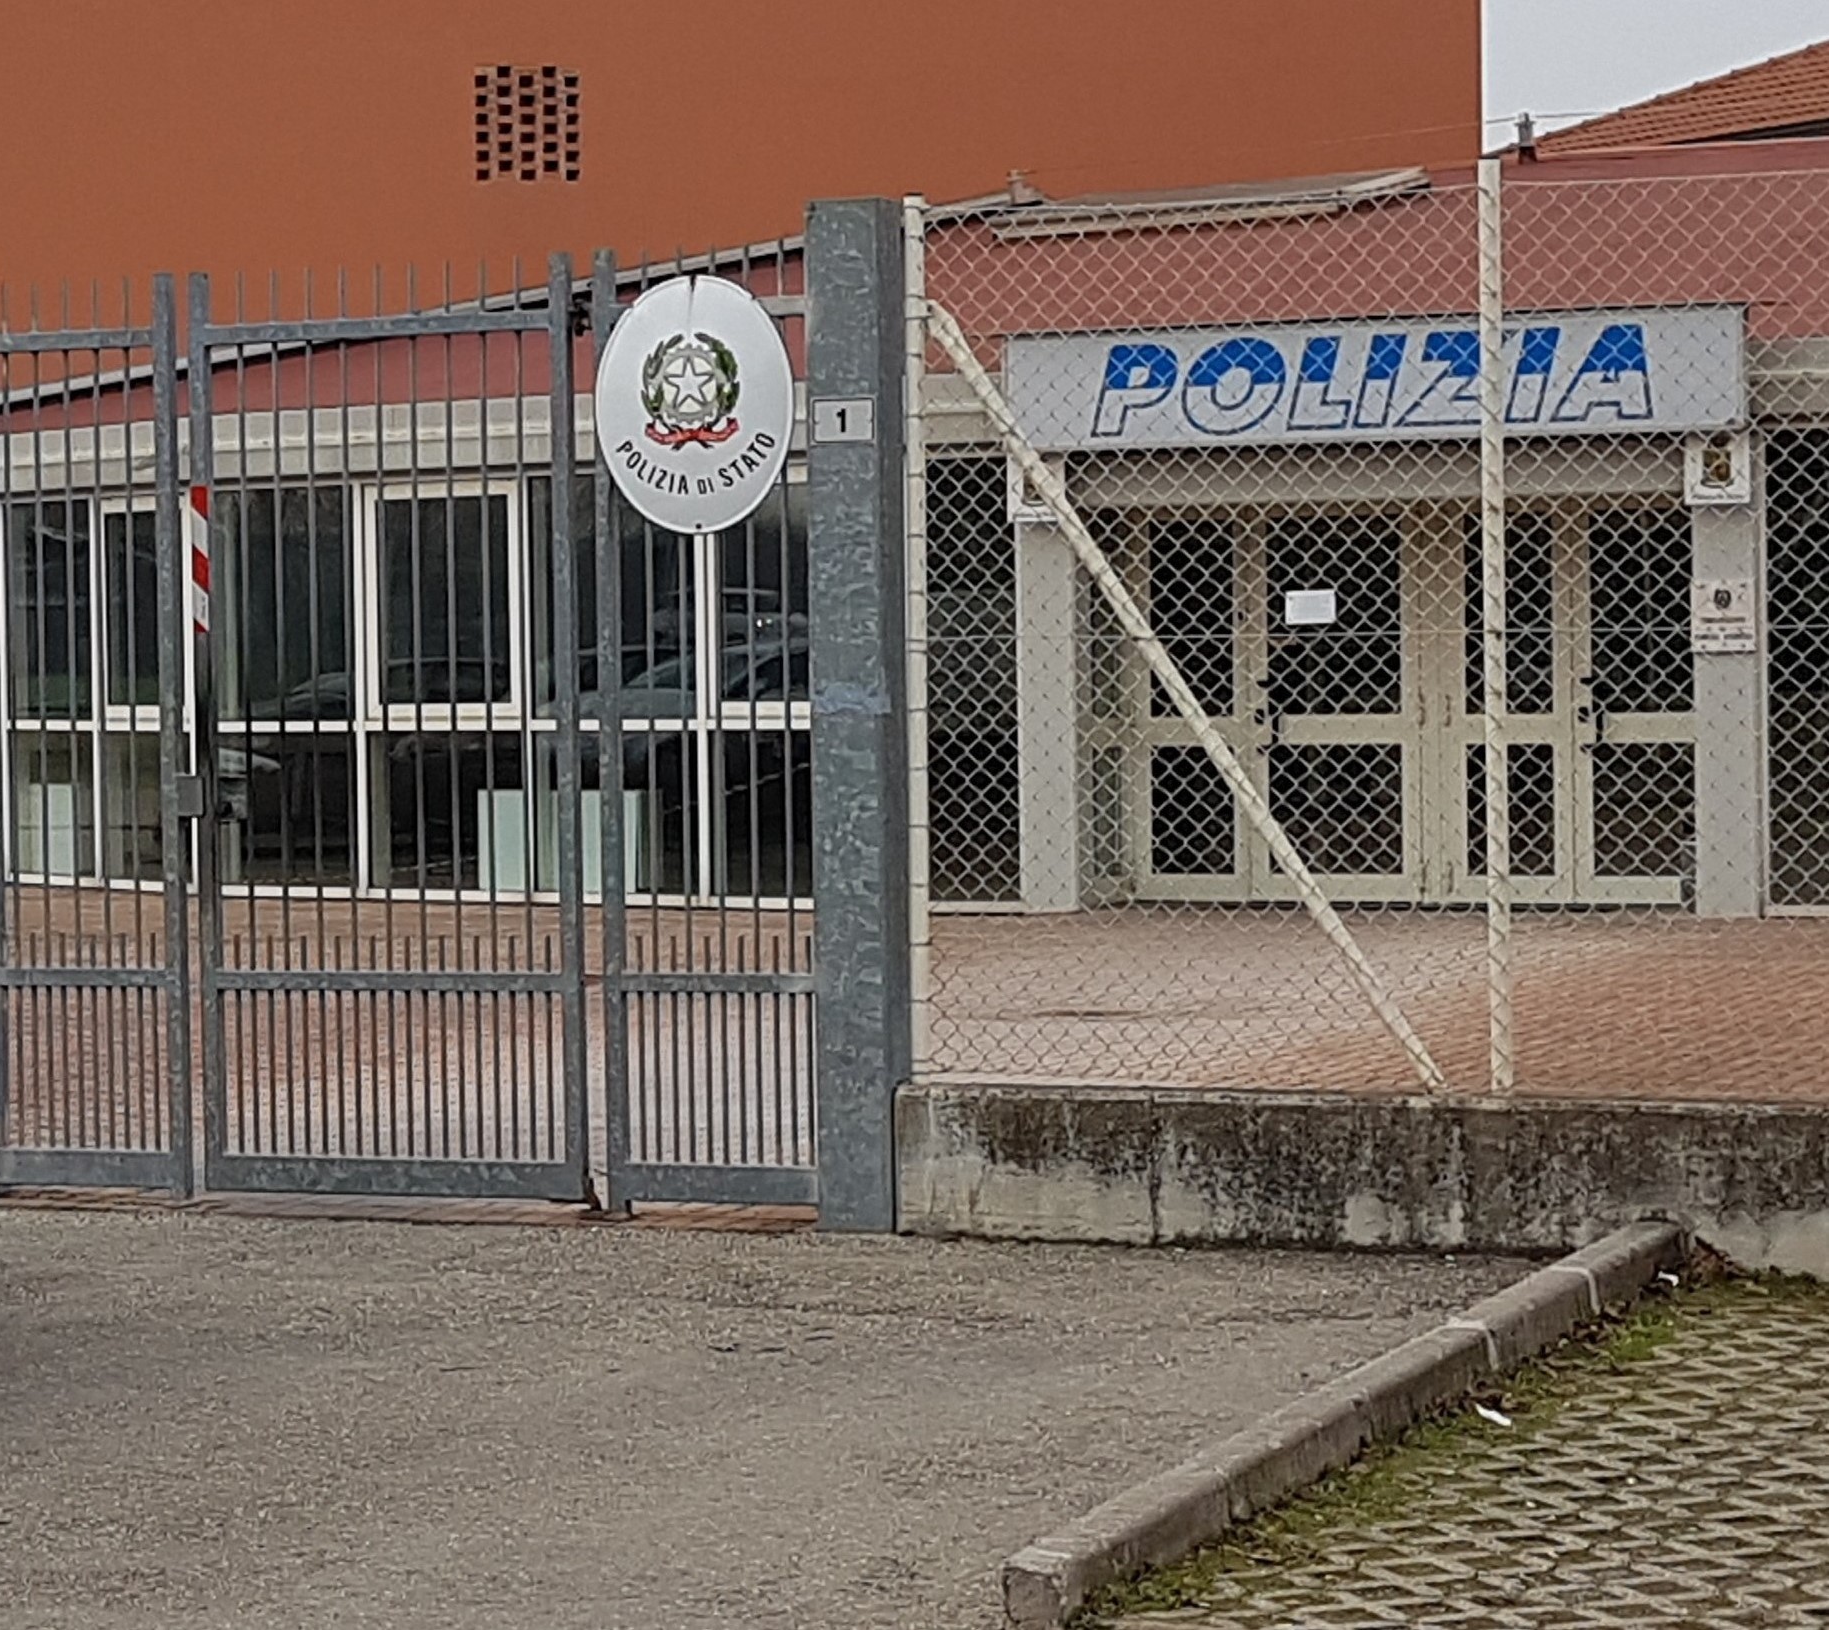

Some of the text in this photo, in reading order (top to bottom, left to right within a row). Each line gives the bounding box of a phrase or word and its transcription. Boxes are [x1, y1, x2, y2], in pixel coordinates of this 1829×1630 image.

[1091, 323, 1654, 438] POLIZIA
[836, 408, 847, 433] 1
[614, 430, 777, 495] POLIZIA DI STATO
